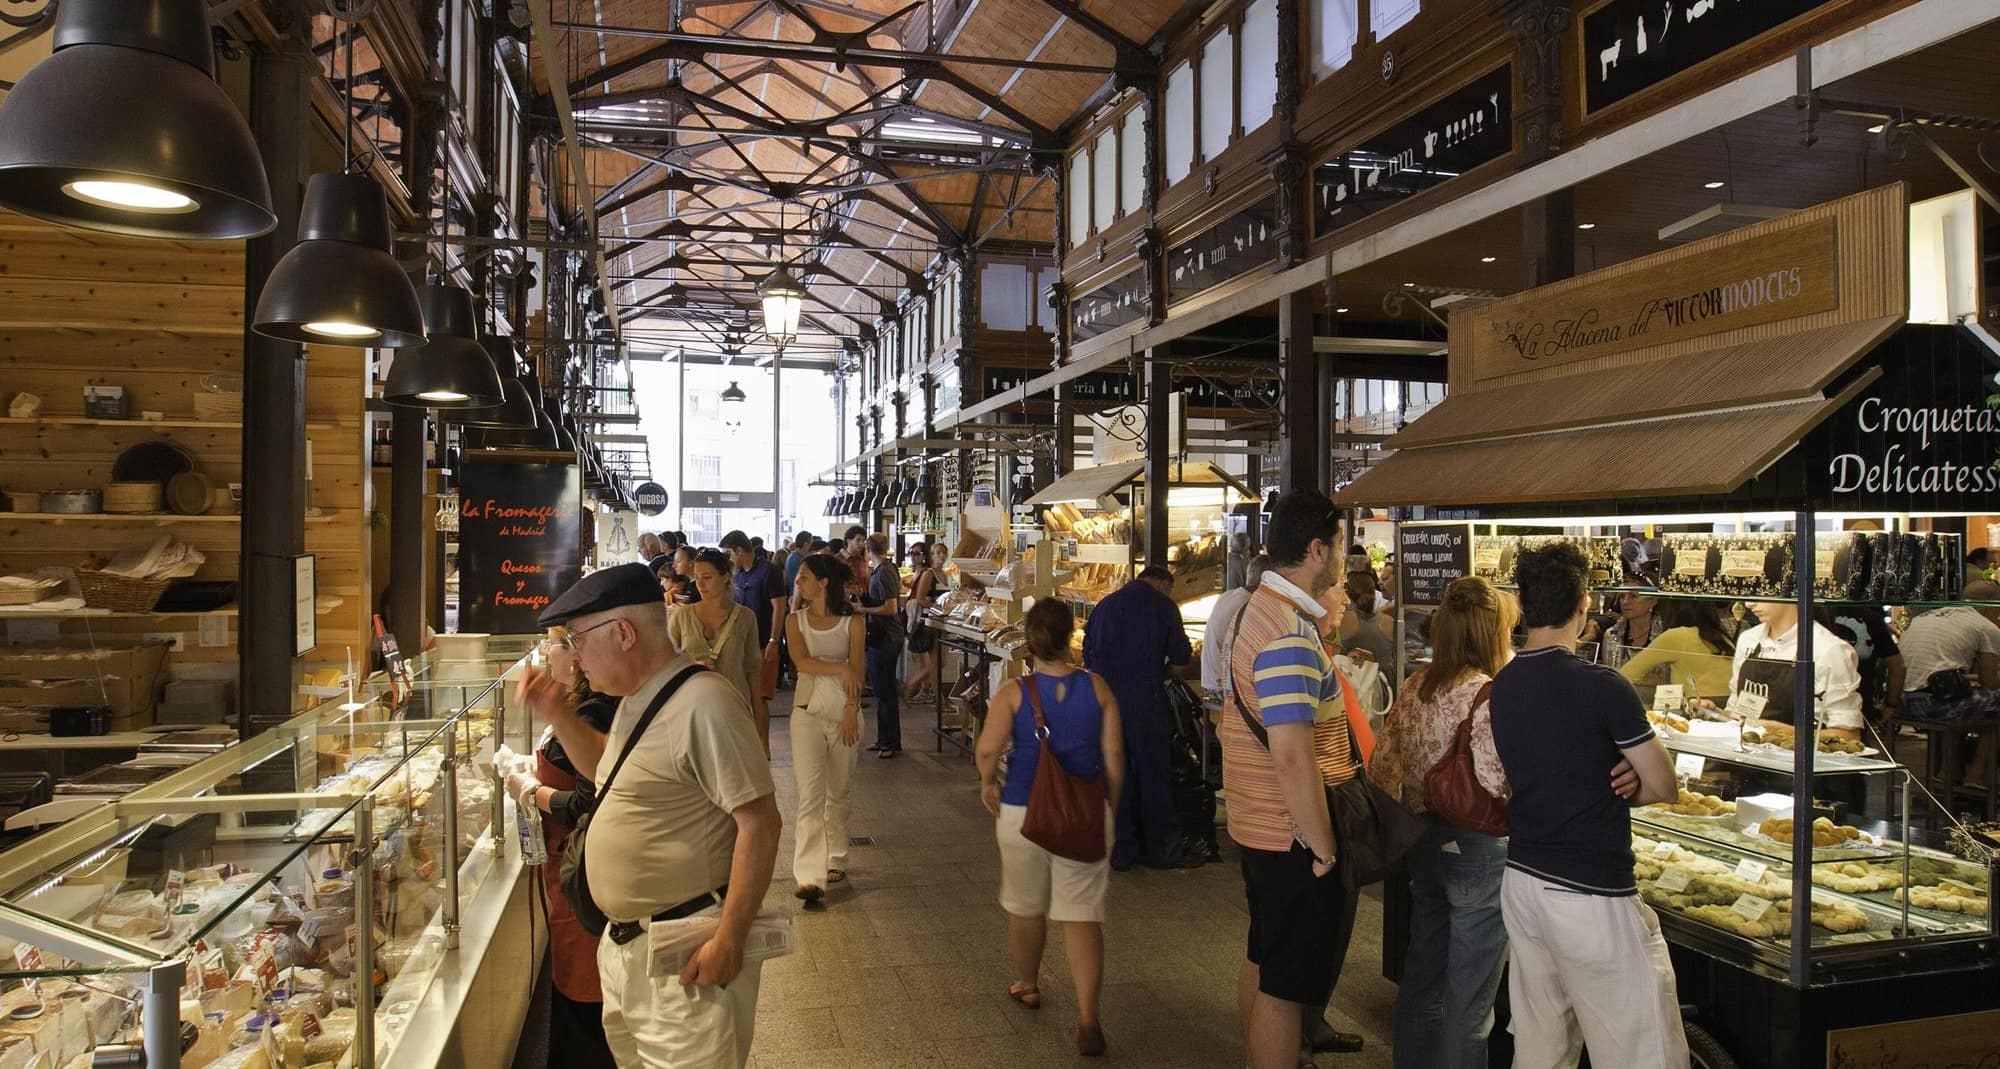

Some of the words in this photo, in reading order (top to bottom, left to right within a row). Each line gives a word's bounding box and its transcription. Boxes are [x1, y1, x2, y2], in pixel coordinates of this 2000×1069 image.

[1544, 308, 1622, 356] Alacena
[1628, 298, 1662, 337] del
[1829, 443, 2000, 494] Delicatess
[638, 493, 666, 506] JUGOSA
[499, 527, 511, 536] de
[512, 525, 546, 537] Madrid
[500, 559, 542, 575] Quesos
[516, 580, 527, 592] y
[495, 591, 549, 611] Fromages
